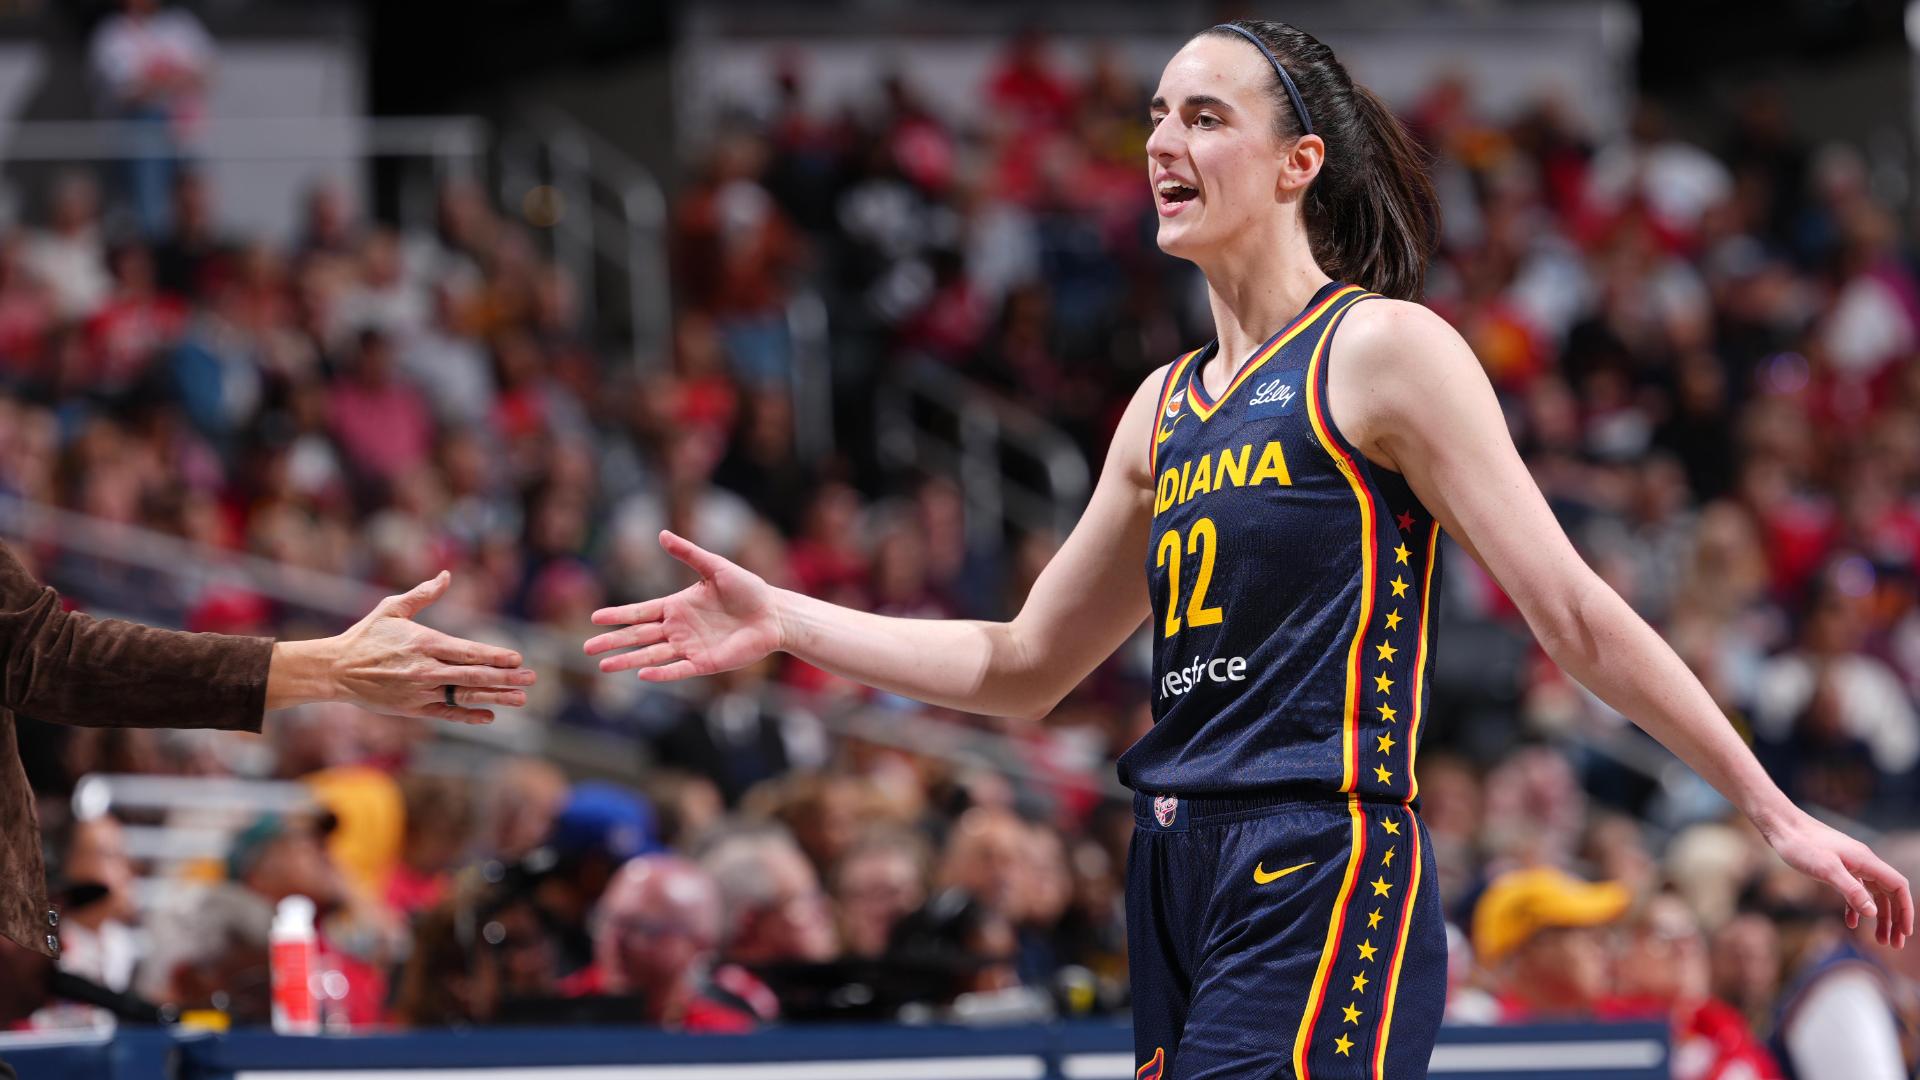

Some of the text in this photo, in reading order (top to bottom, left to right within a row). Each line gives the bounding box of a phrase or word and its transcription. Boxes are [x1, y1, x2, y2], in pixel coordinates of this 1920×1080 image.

[1249, 378, 1296, 408] Lilly
[1153, 441, 1292, 518] DIANA
[1157, 517, 1223, 639] 22
